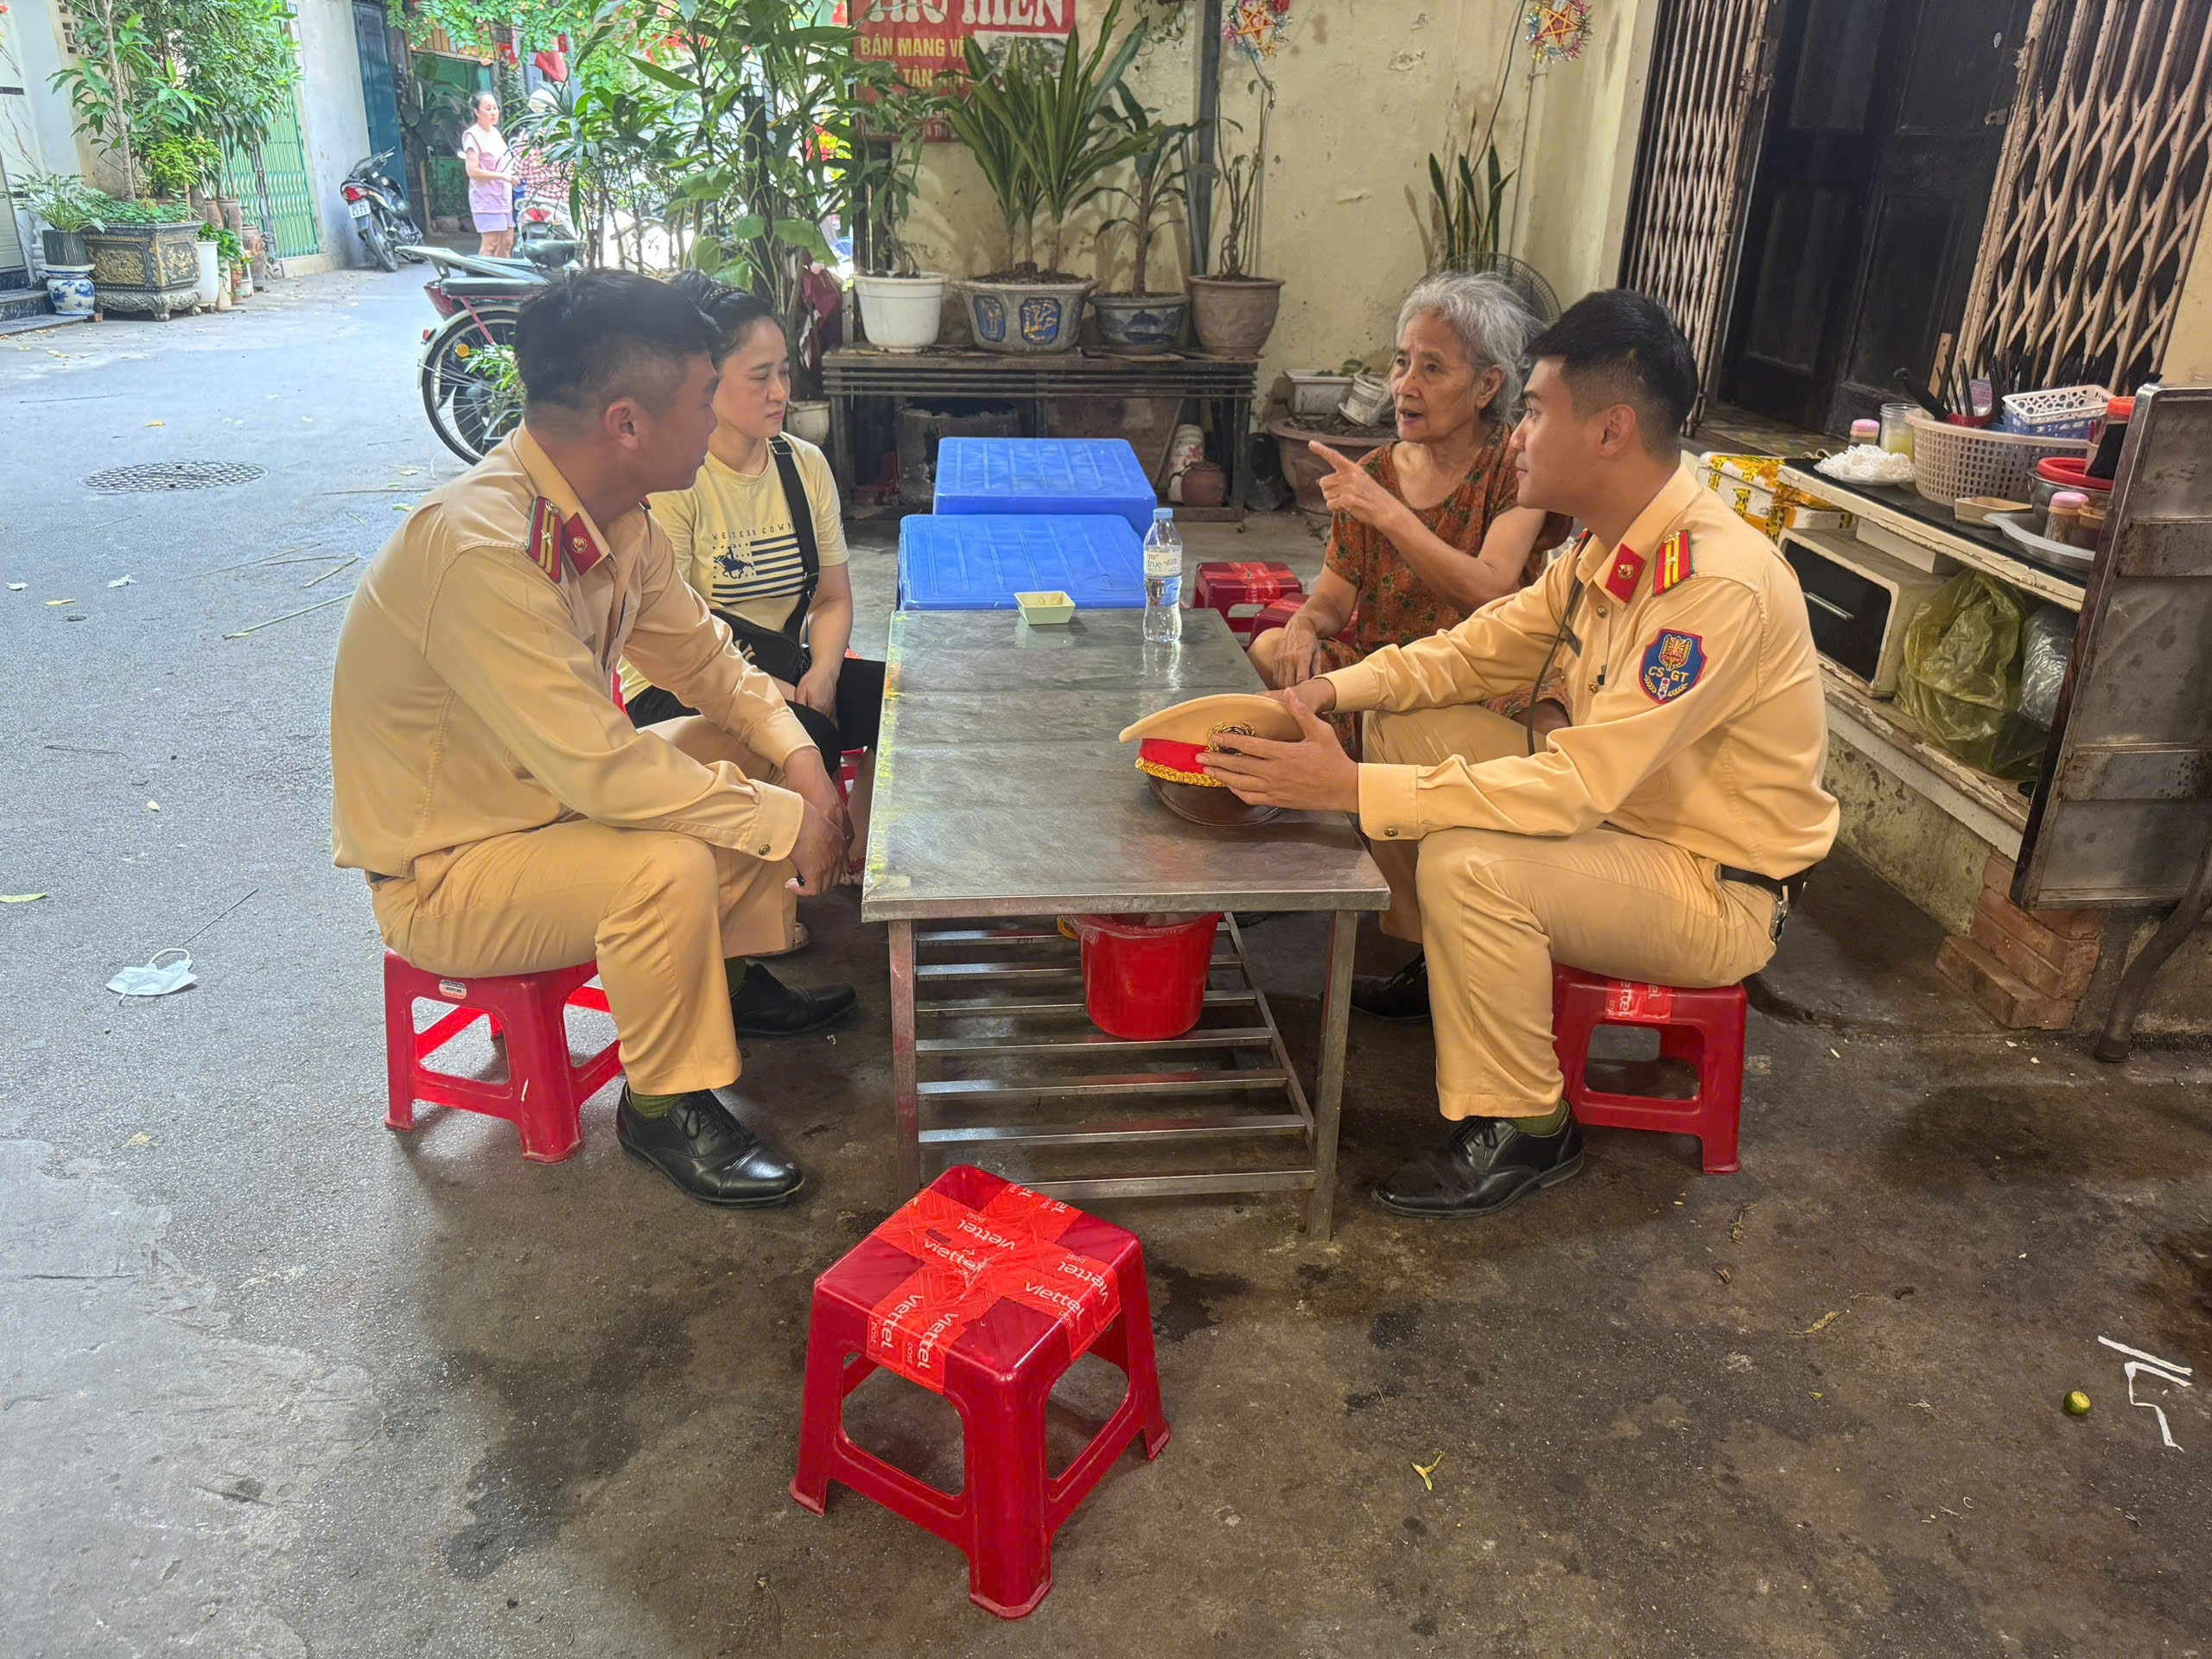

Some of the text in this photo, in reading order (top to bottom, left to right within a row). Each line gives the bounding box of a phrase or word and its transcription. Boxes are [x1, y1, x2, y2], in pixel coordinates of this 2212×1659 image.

[860, 33, 893, 56] BÁN
[898, 37, 946, 56] MANG
[1648, 665, 1690, 683] CS GT
[957, 1218, 1016, 1251] viettel
[965, 1211, 987, 1224] post
[924, 1238, 982, 1273] viettel
[1024, 1281, 1085, 1321] viettel
[1057, 1261, 1109, 1306] viettel
[880, 1294, 925, 1349] viettel
[918, 1313, 959, 1370] viettel
